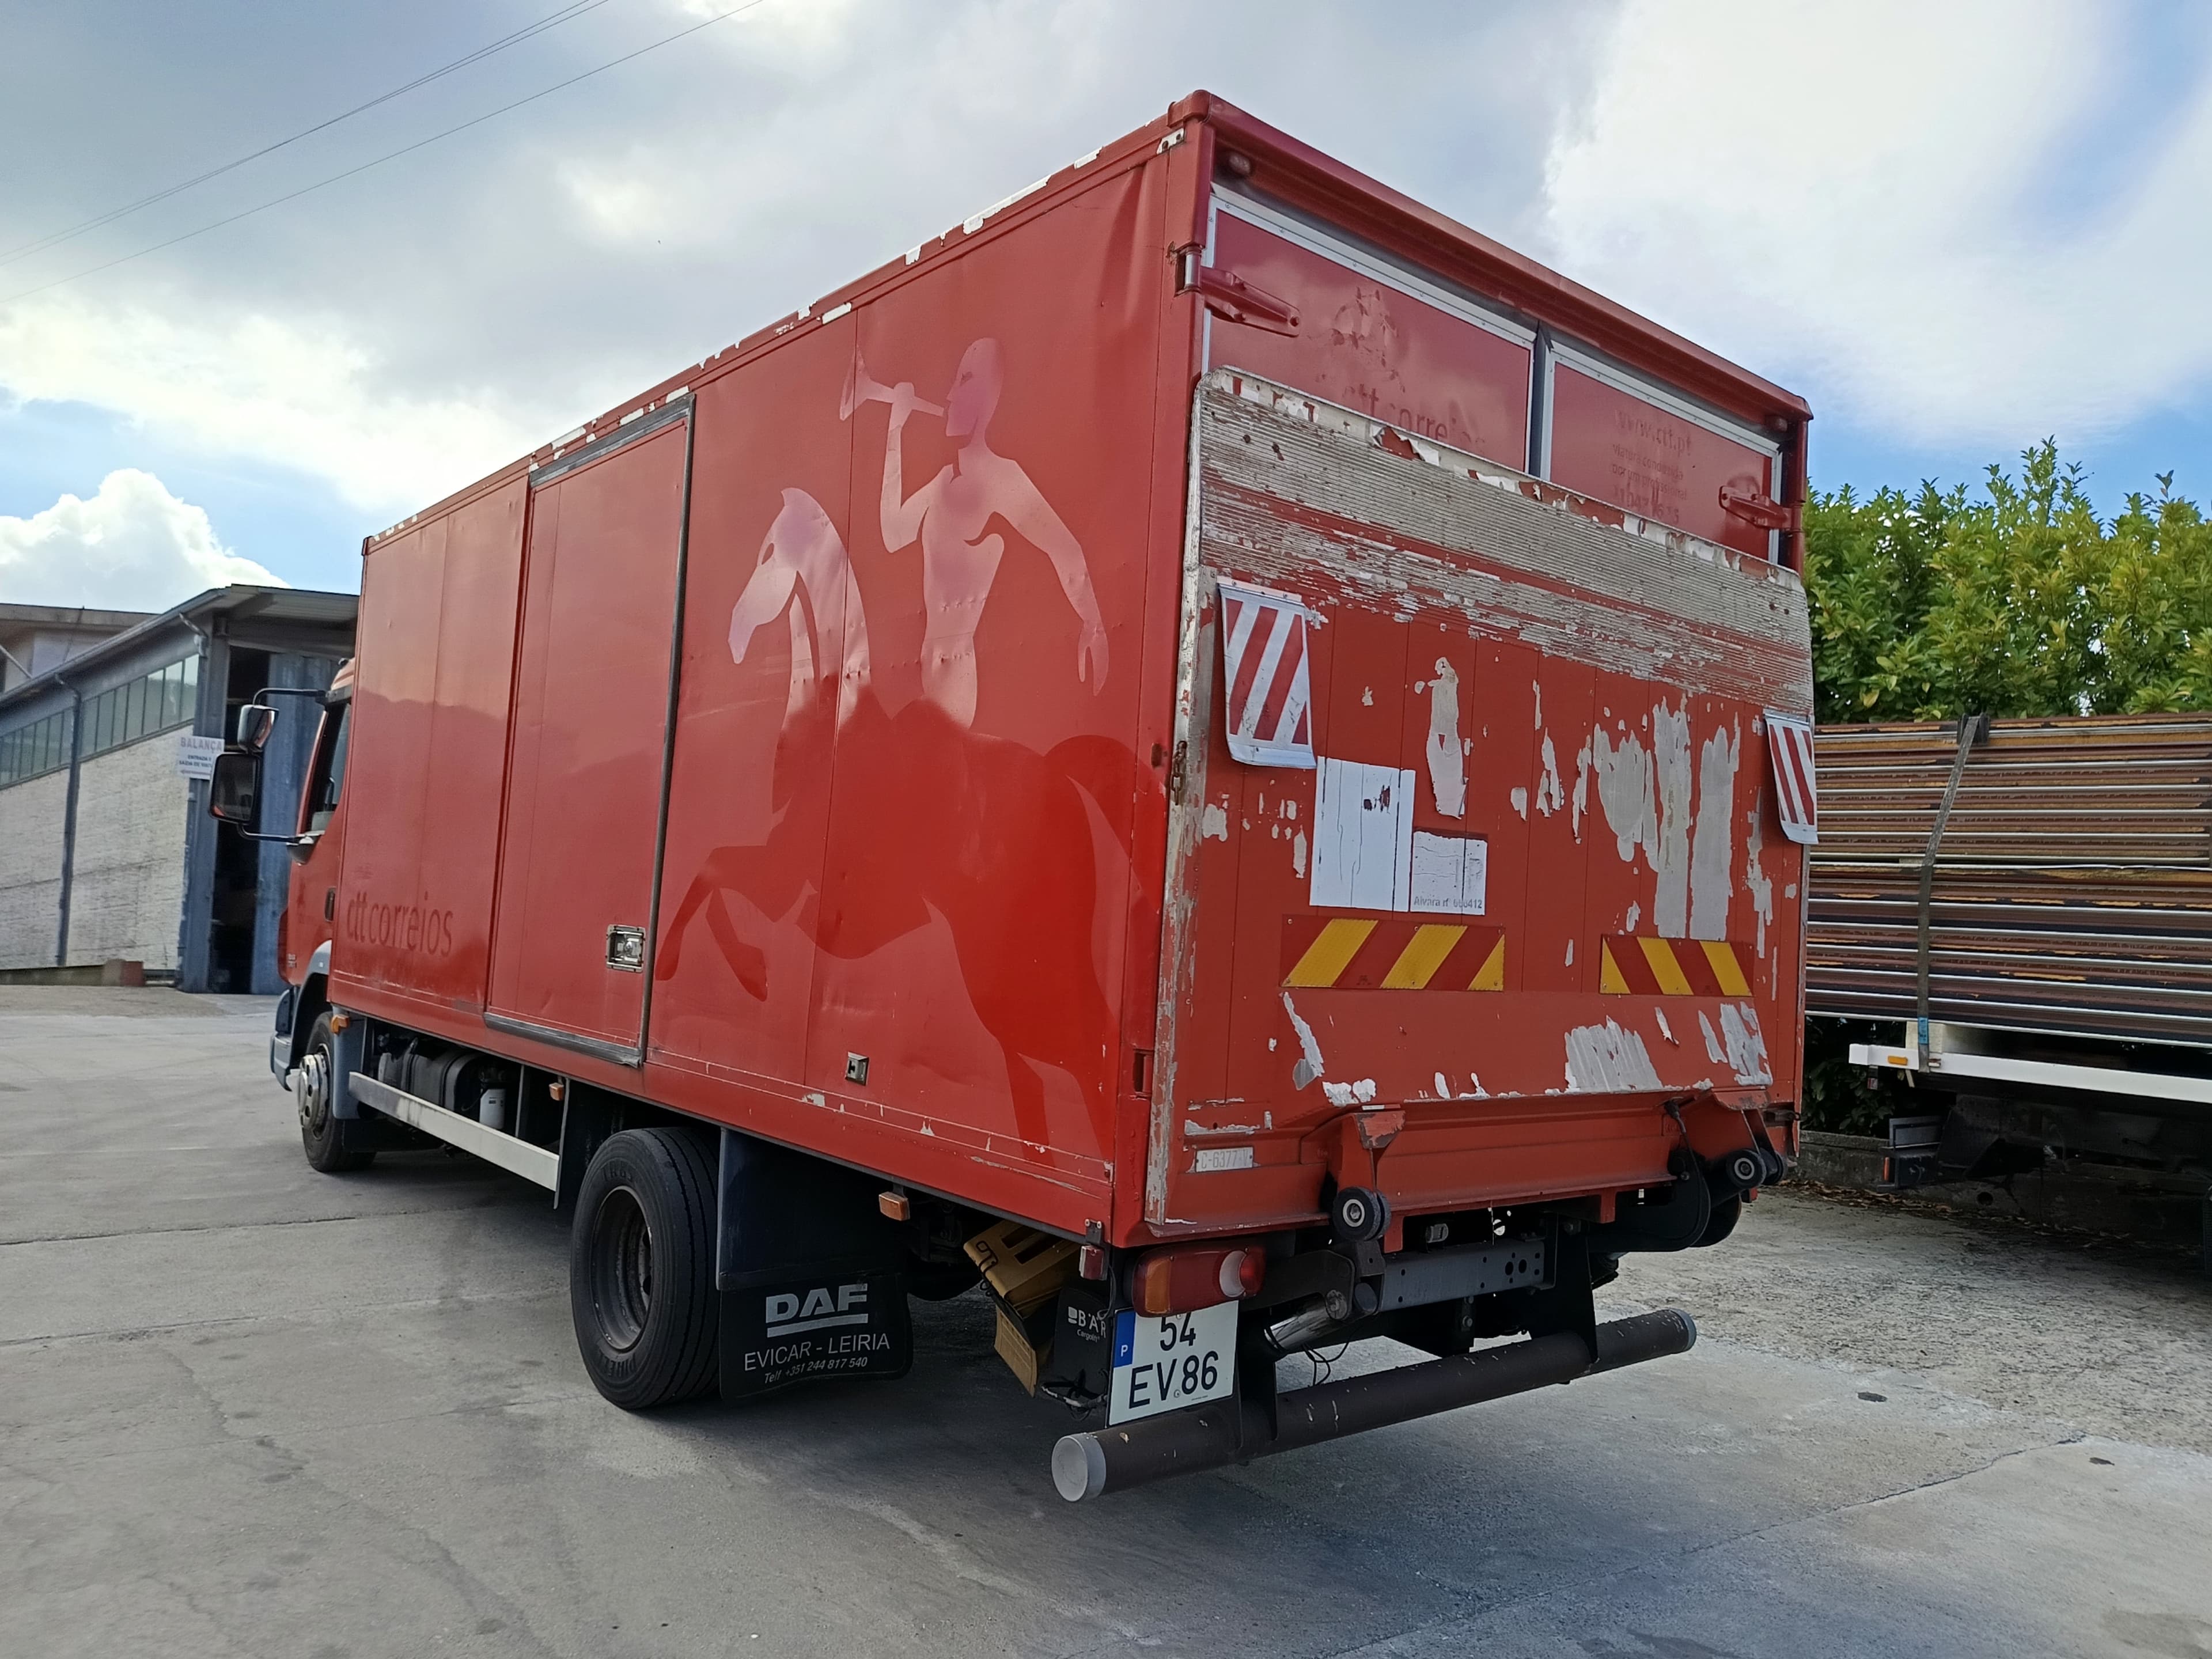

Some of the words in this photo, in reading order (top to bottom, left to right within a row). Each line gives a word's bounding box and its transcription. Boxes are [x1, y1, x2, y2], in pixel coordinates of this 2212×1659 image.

[181, 737, 222, 753] BALANÇA
[766, 1283, 868, 1324] DAF
[1160, 1312, 1196, 1351] 54
[745, 1341, 812, 1372] EVICAR
[828, 1333, 890, 1354] LEIRIA
[1121, 1344, 1128, 1357] P
[785, 1363, 806, 1377] +351
[808, 1359, 826, 1372] 244
[828, 1358, 847, 1369] 817
[849, 1357, 868, 1368] 540
